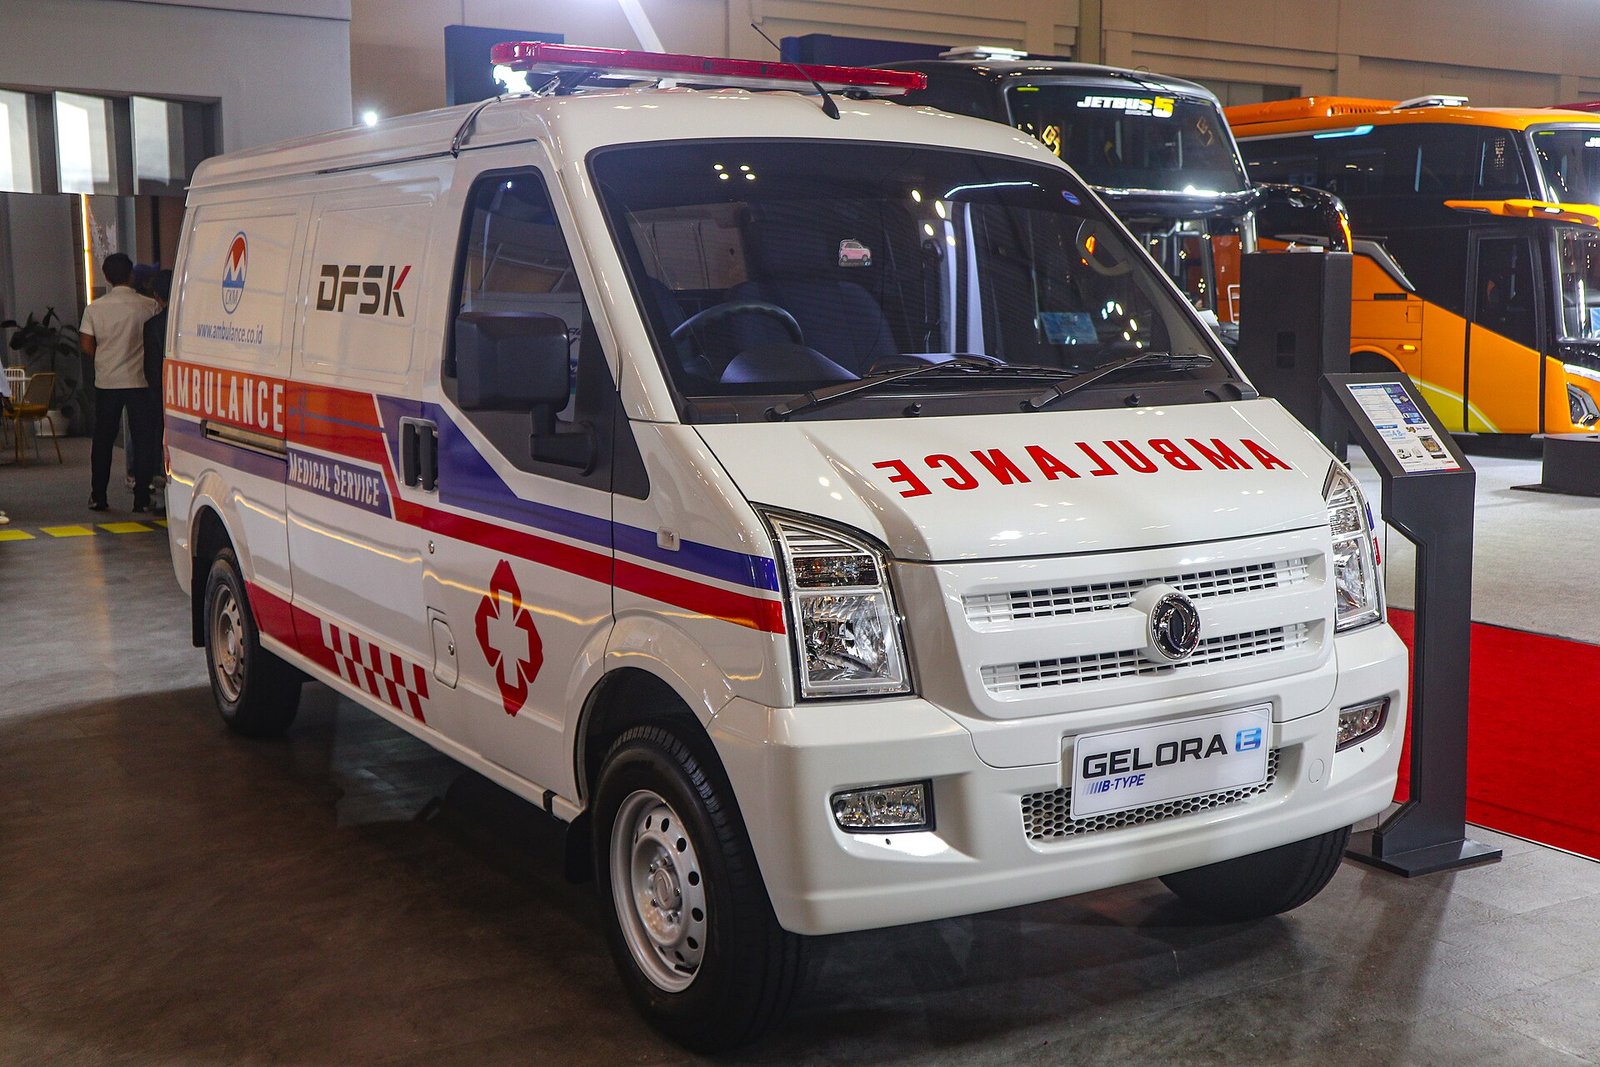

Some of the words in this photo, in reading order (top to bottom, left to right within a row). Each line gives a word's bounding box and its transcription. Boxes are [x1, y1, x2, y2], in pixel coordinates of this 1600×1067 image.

[1077, 96, 1153, 110] JETBUS
[1153, 96, 1175, 118] 5
[316, 264, 412, 317] DFSK
[196, 321, 264, 345] www.ambulance.co.id
[165, 363, 284, 433] AMBULANCE
[288, 451, 331, 492] MEDICAL
[333, 463, 380, 506] SERVICE
[1082, 733, 1228, 779] GELORA
[1235, 727, 1262, 752] E
[1101, 773, 1146, 792] B-TYPE
